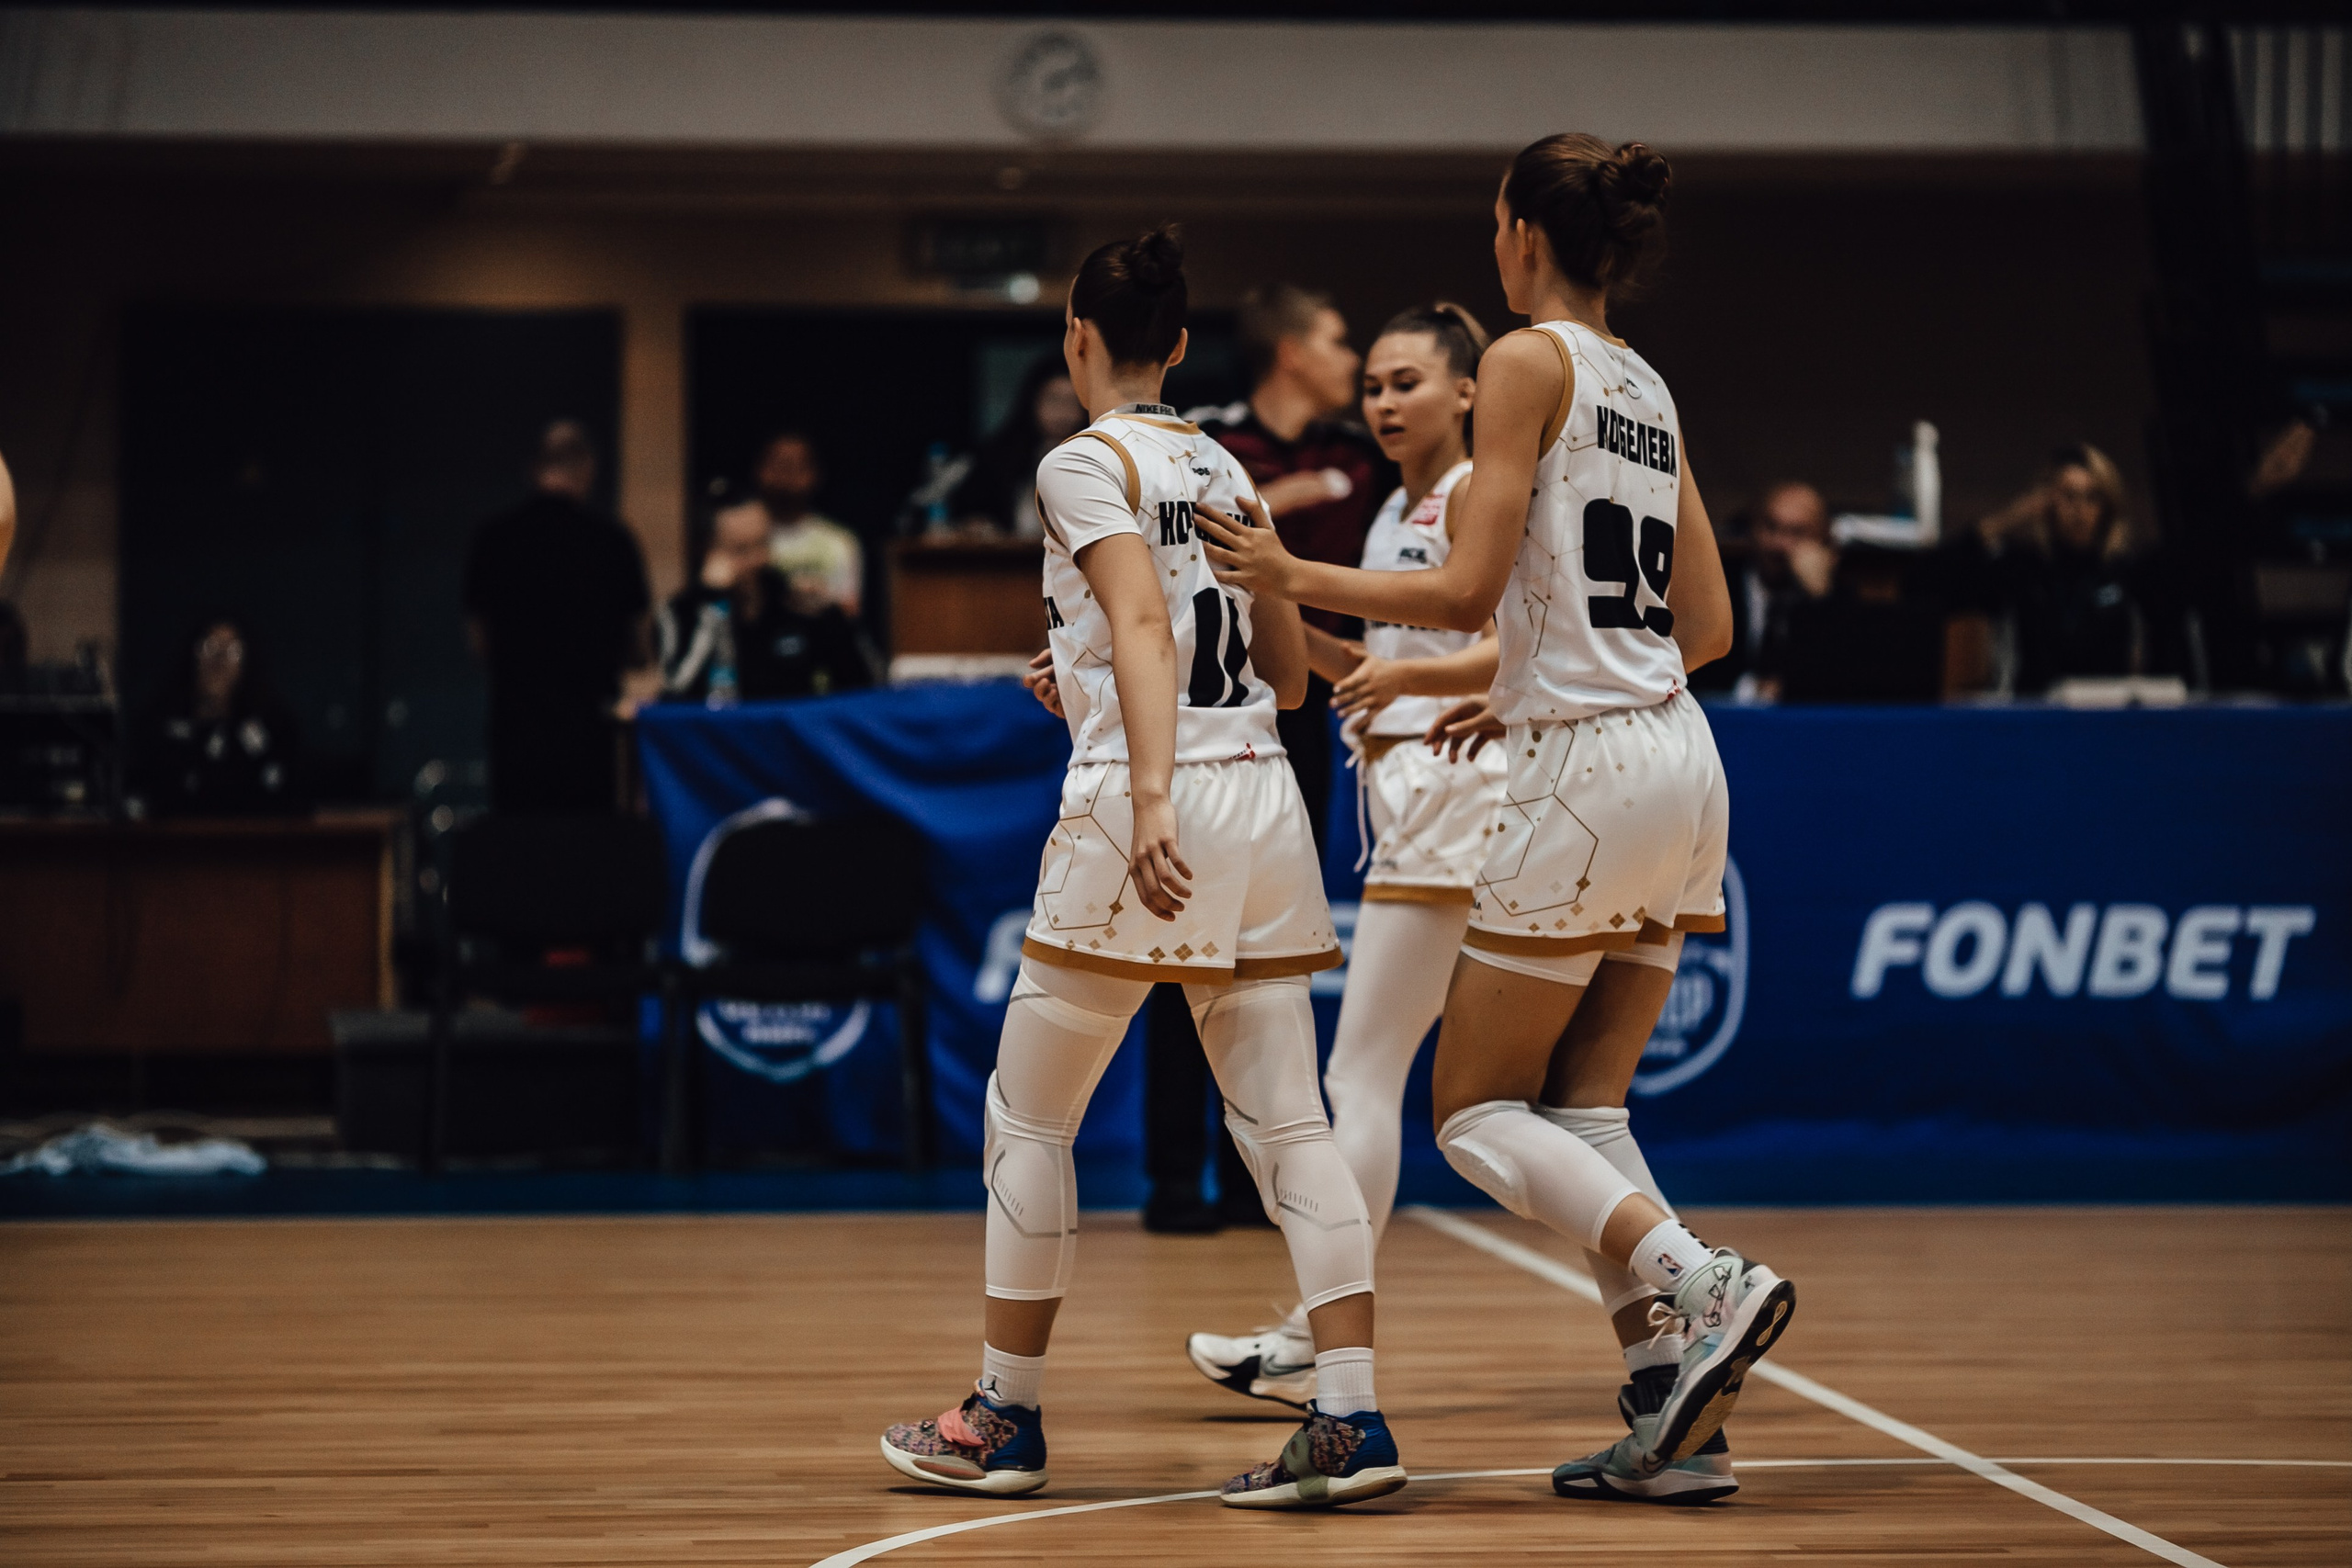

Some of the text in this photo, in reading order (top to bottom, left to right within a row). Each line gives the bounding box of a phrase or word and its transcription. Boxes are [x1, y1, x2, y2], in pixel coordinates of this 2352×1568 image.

[1136, 403, 1158, 413] NIKE
[1596, 405, 1677, 478] КОБЕЛЕВА
[1583, 498, 1675, 637] 99
[1850, 901, 2316, 1000] FONBET
